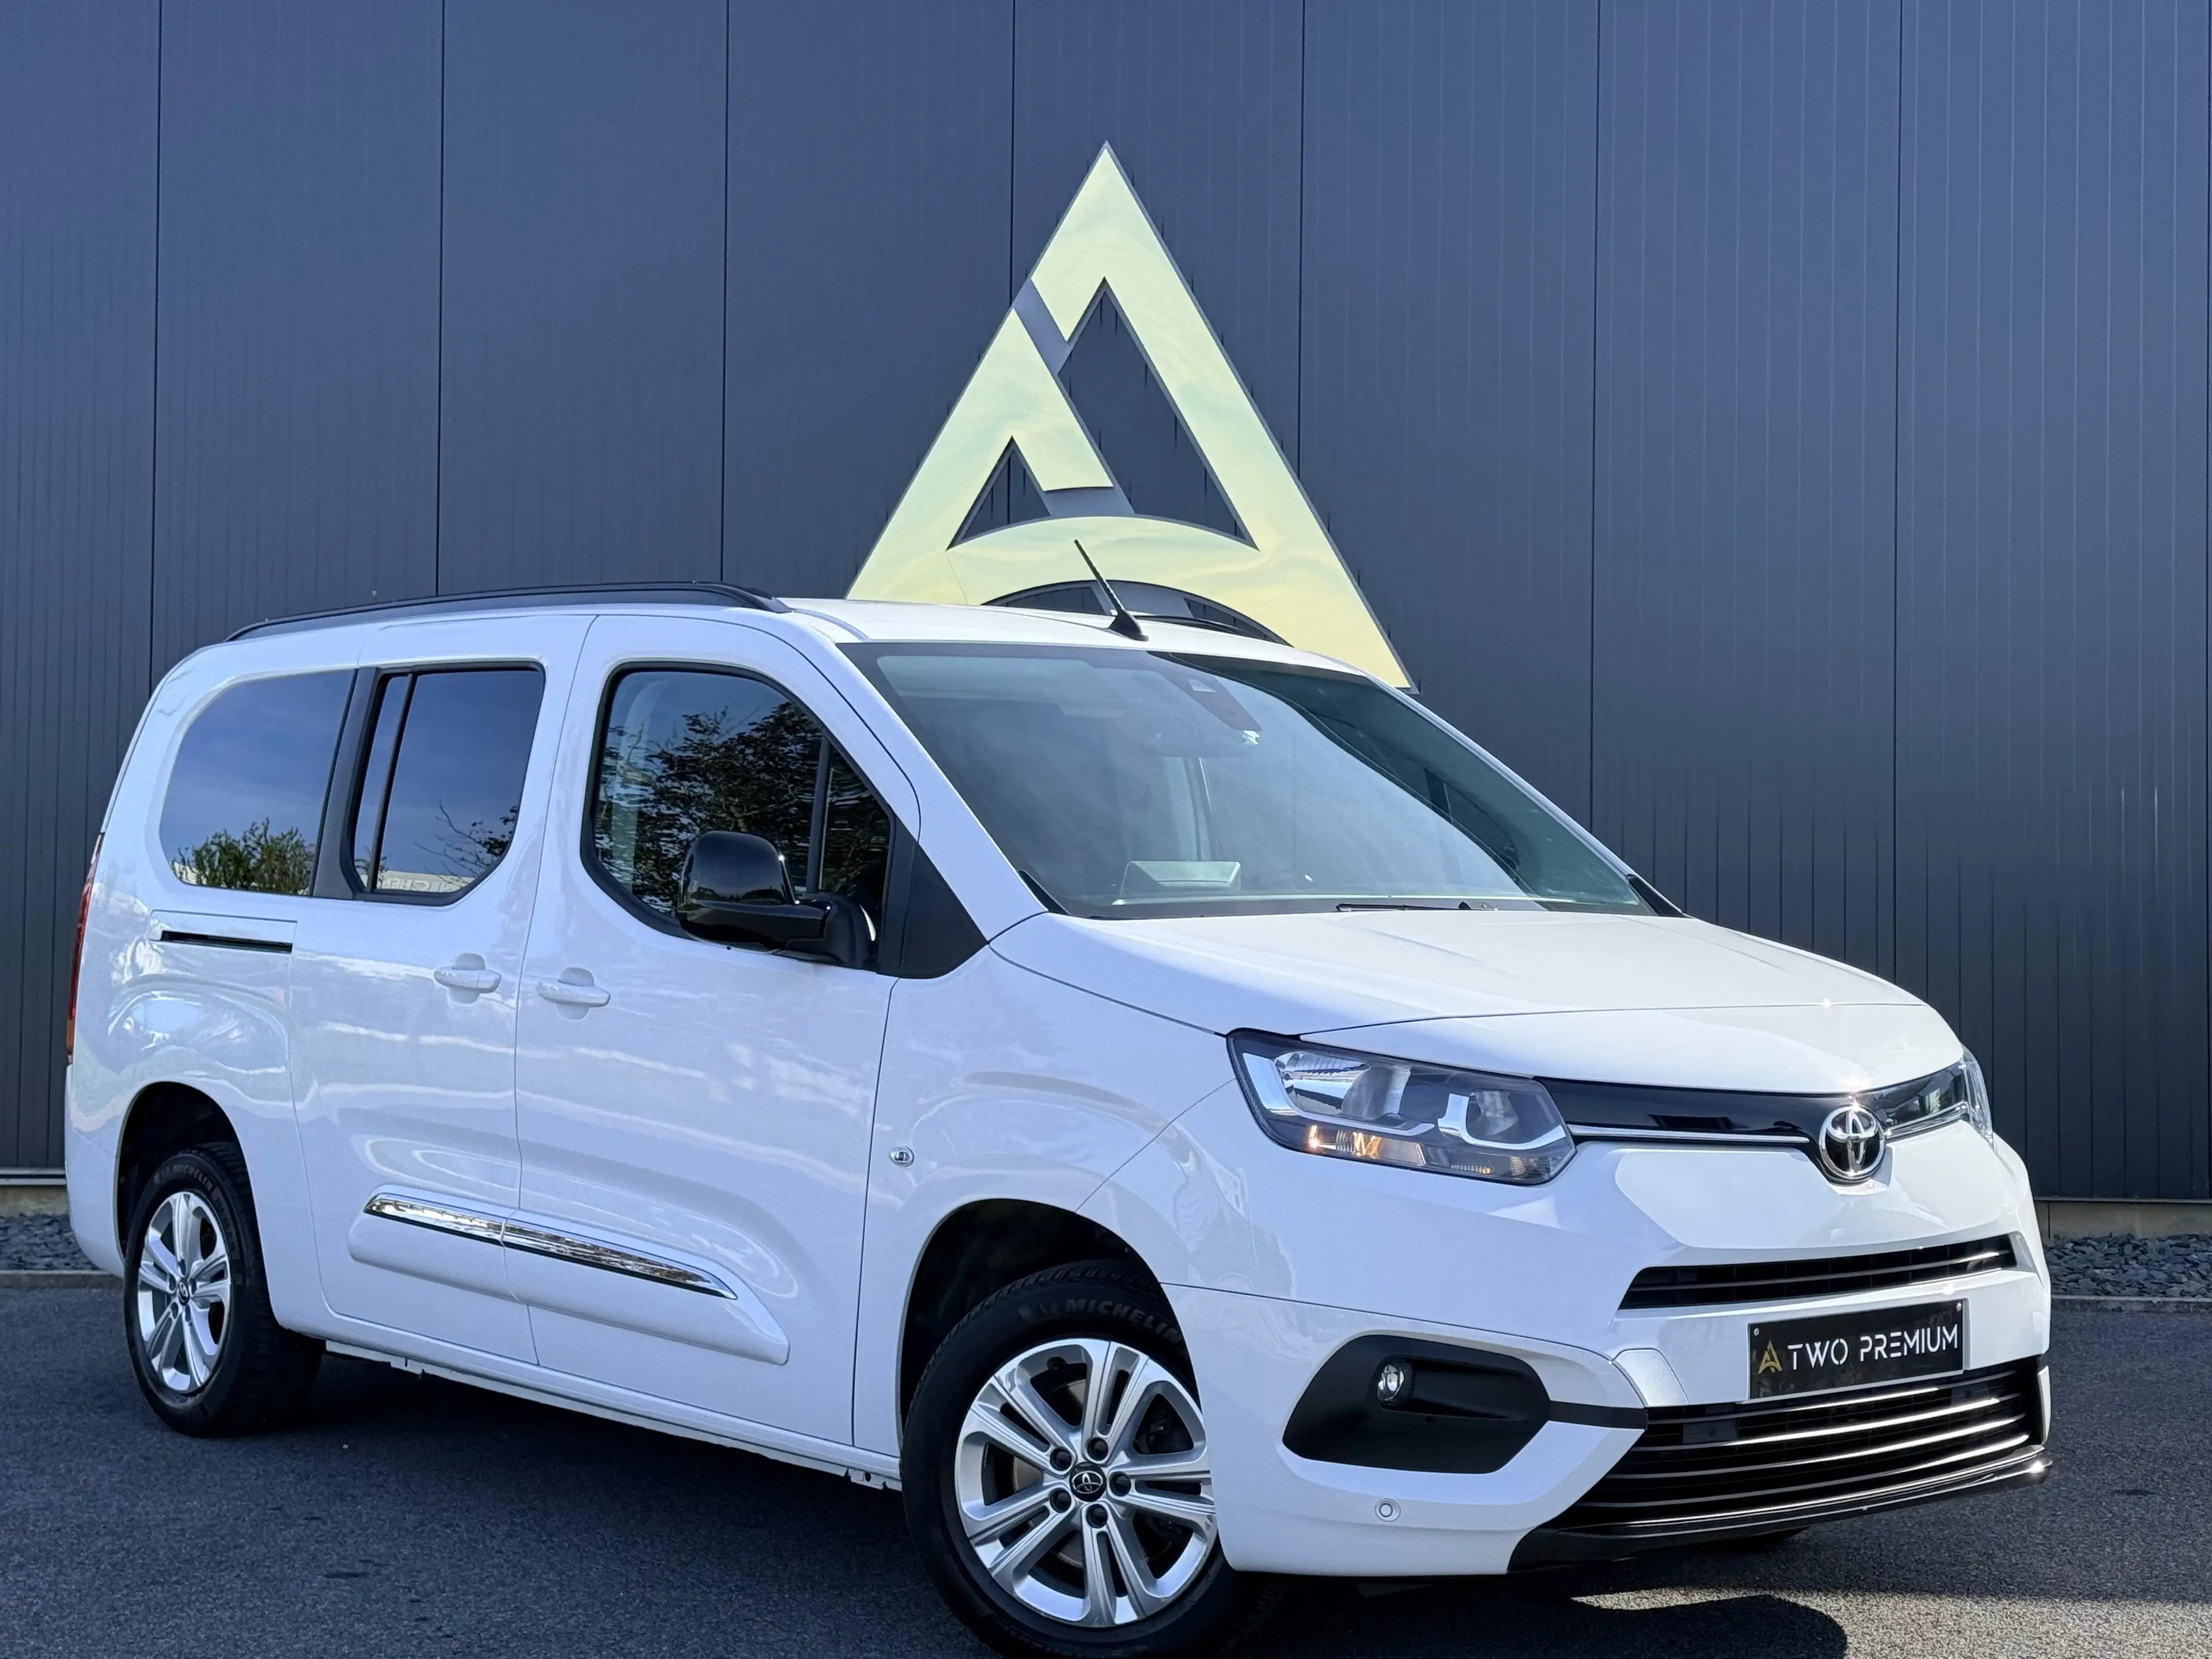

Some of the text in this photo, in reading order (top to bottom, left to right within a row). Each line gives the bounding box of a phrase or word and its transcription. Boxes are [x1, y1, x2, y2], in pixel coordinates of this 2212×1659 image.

[1066, 1298, 1183, 1344] MICHELIN
[1787, 1338, 1849, 1370] TWO
[1859, 1324, 1958, 1363] PREMIUM
